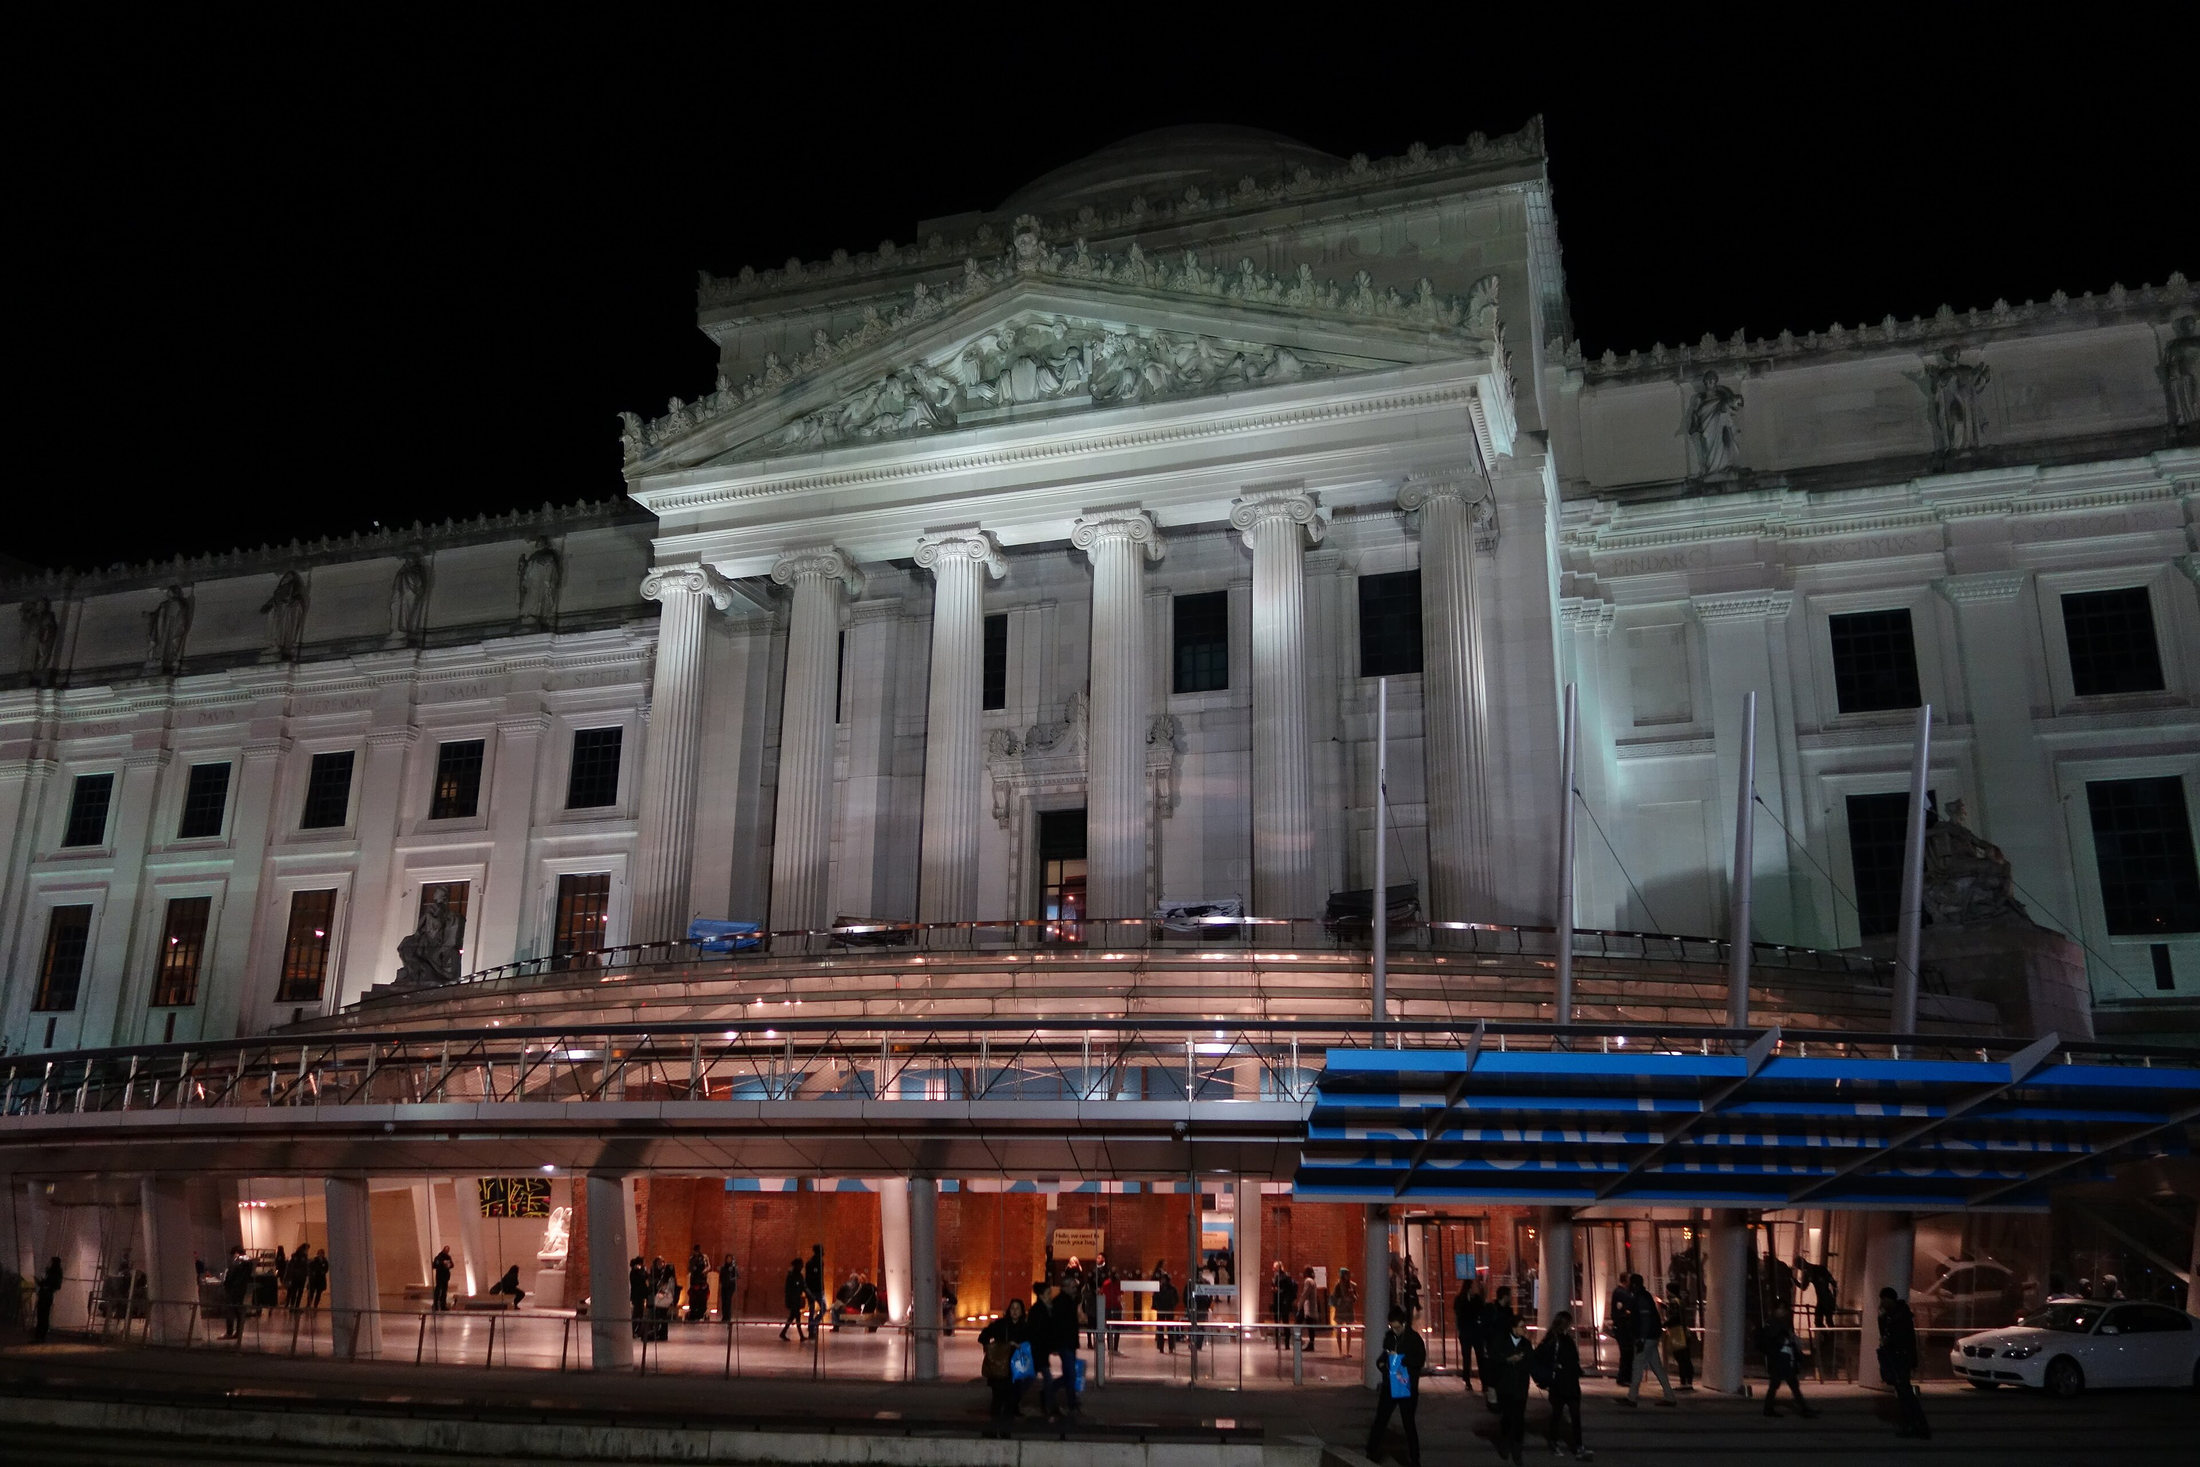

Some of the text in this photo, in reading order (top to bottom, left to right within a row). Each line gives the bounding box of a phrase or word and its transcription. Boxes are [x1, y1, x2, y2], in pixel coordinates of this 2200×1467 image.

[1613, 552, 1687, 574] PINDAR
[444, 682, 489, 701] ISAIAH
[198, 709, 236, 724] DAVID
